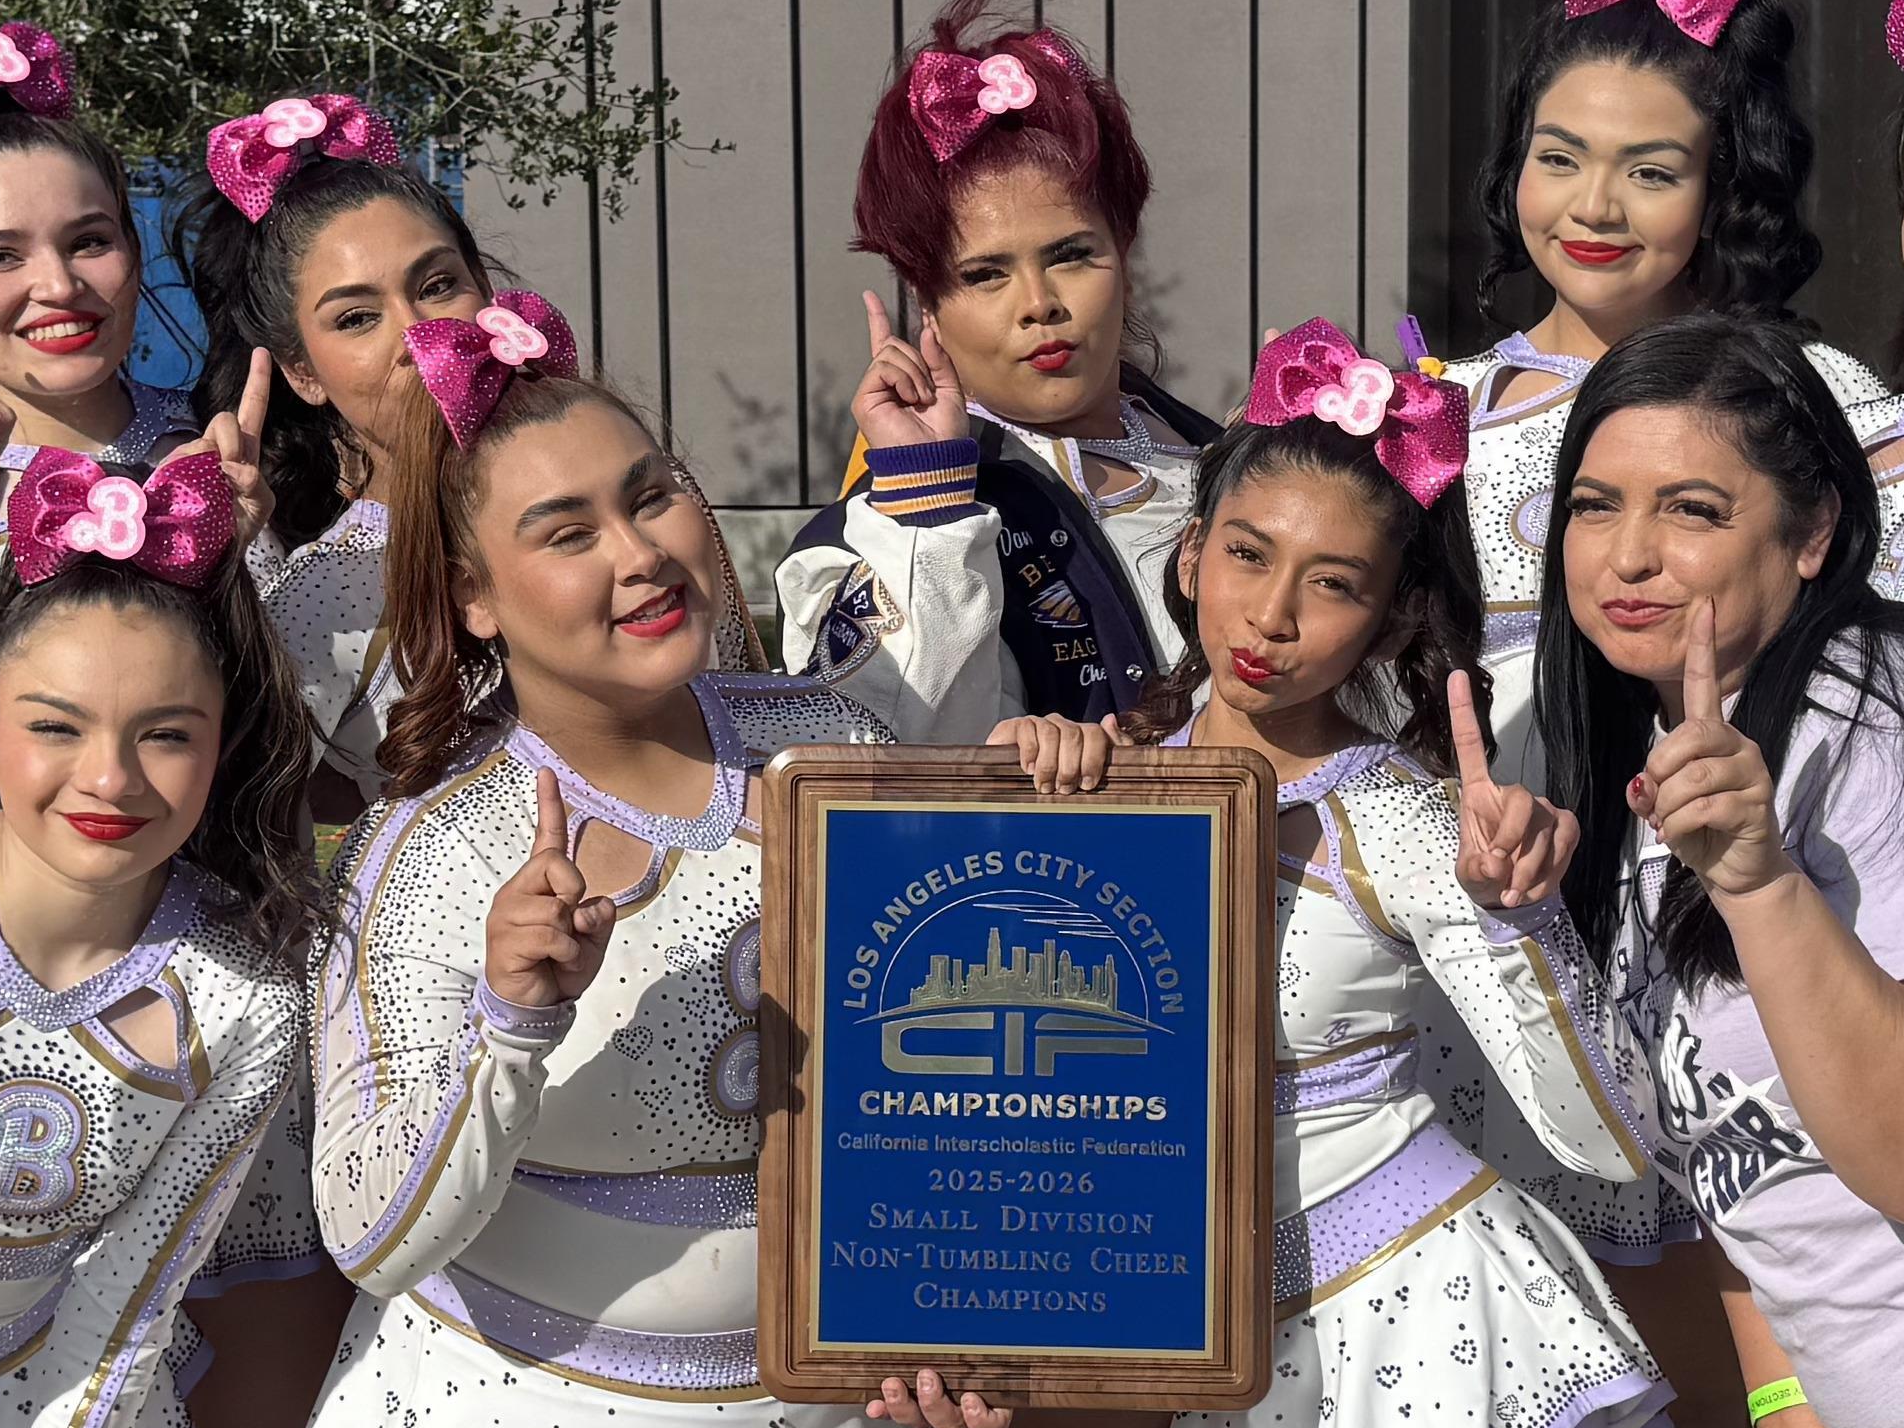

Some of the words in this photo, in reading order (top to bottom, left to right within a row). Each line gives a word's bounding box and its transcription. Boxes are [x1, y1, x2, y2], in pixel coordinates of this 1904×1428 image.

[261, 98, 328, 148] B
[475, 305, 548, 366] B
[60, 475, 147, 560] B
[843, 944, 879, 1010] LOS
[871, 851, 1004, 945] ANGELES
[1015, 851, 1095, 889] CITY
[1095, 881, 1184, 1015] SECTION
[881, 1011, 1148, 1077] CIF
[859, 1090, 1168, 1121] CHAMPIONSHIPS
[838, 1132, 929, 1153] California
[934, 1134, 1076, 1156] Interscholastic
[1082, 1136, 1186, 1157] Federation
[928, 1168, 1095, 1194] 2025-2026
